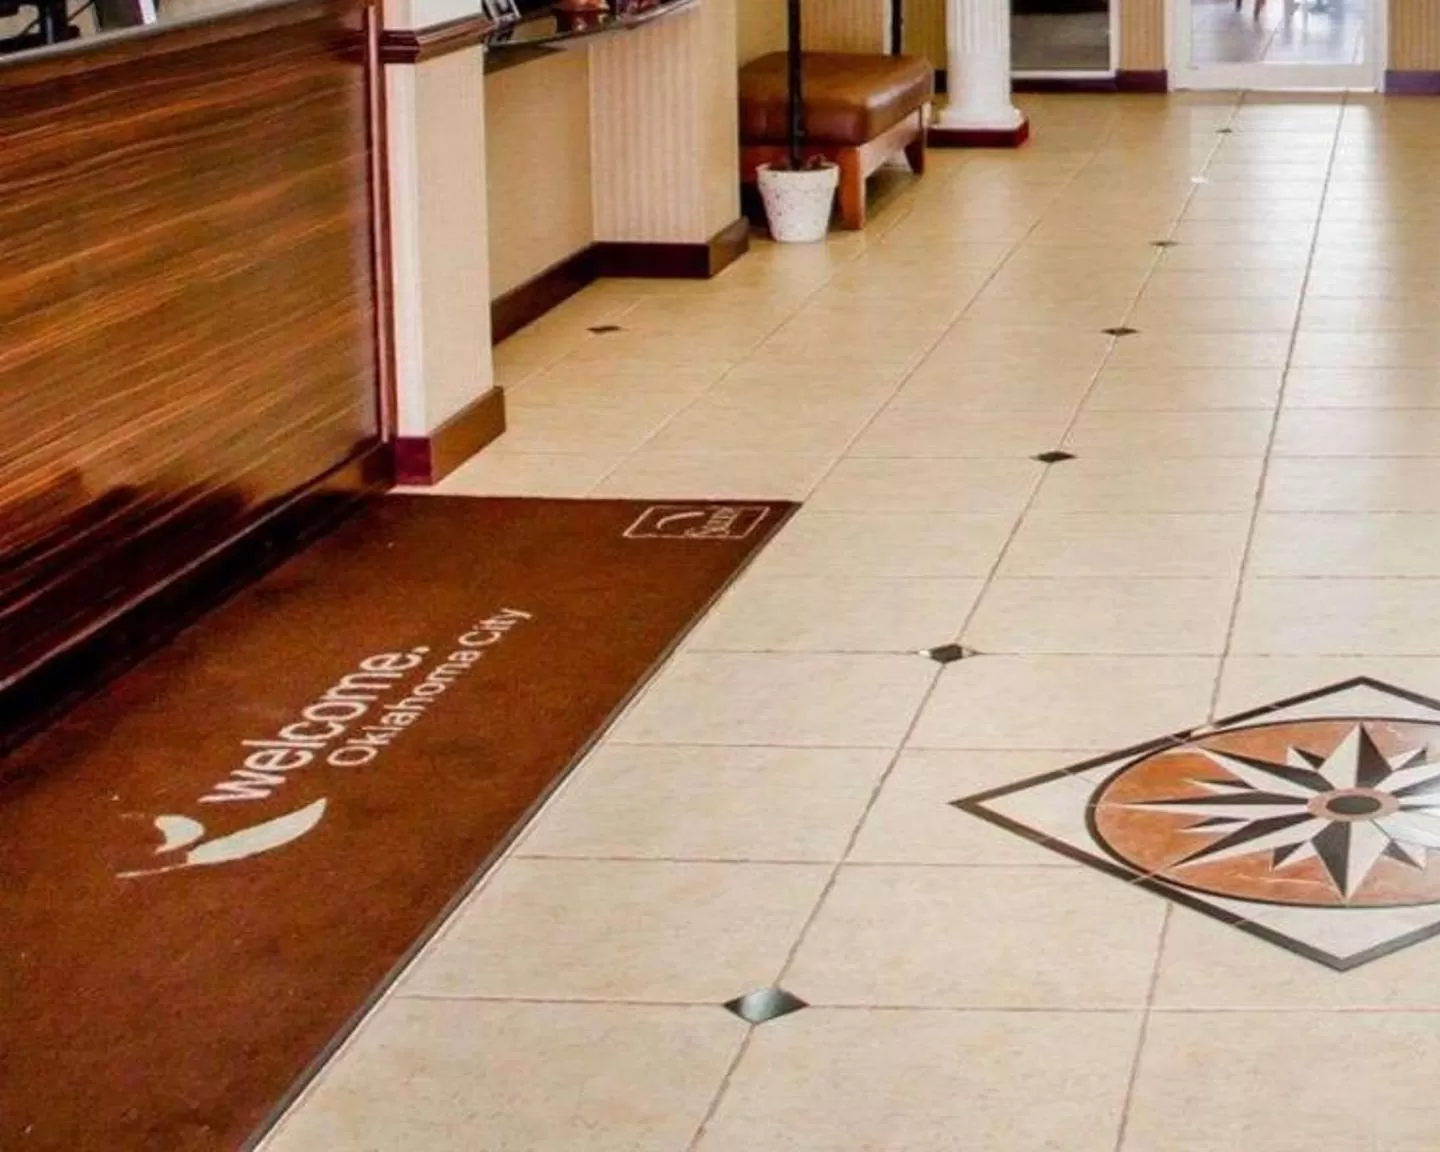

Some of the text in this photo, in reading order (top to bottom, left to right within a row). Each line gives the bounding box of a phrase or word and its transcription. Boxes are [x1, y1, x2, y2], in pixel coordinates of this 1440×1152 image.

[197, 645, 430, 803] welcome.
[327, 607, 533, 767] Oklahoma City
